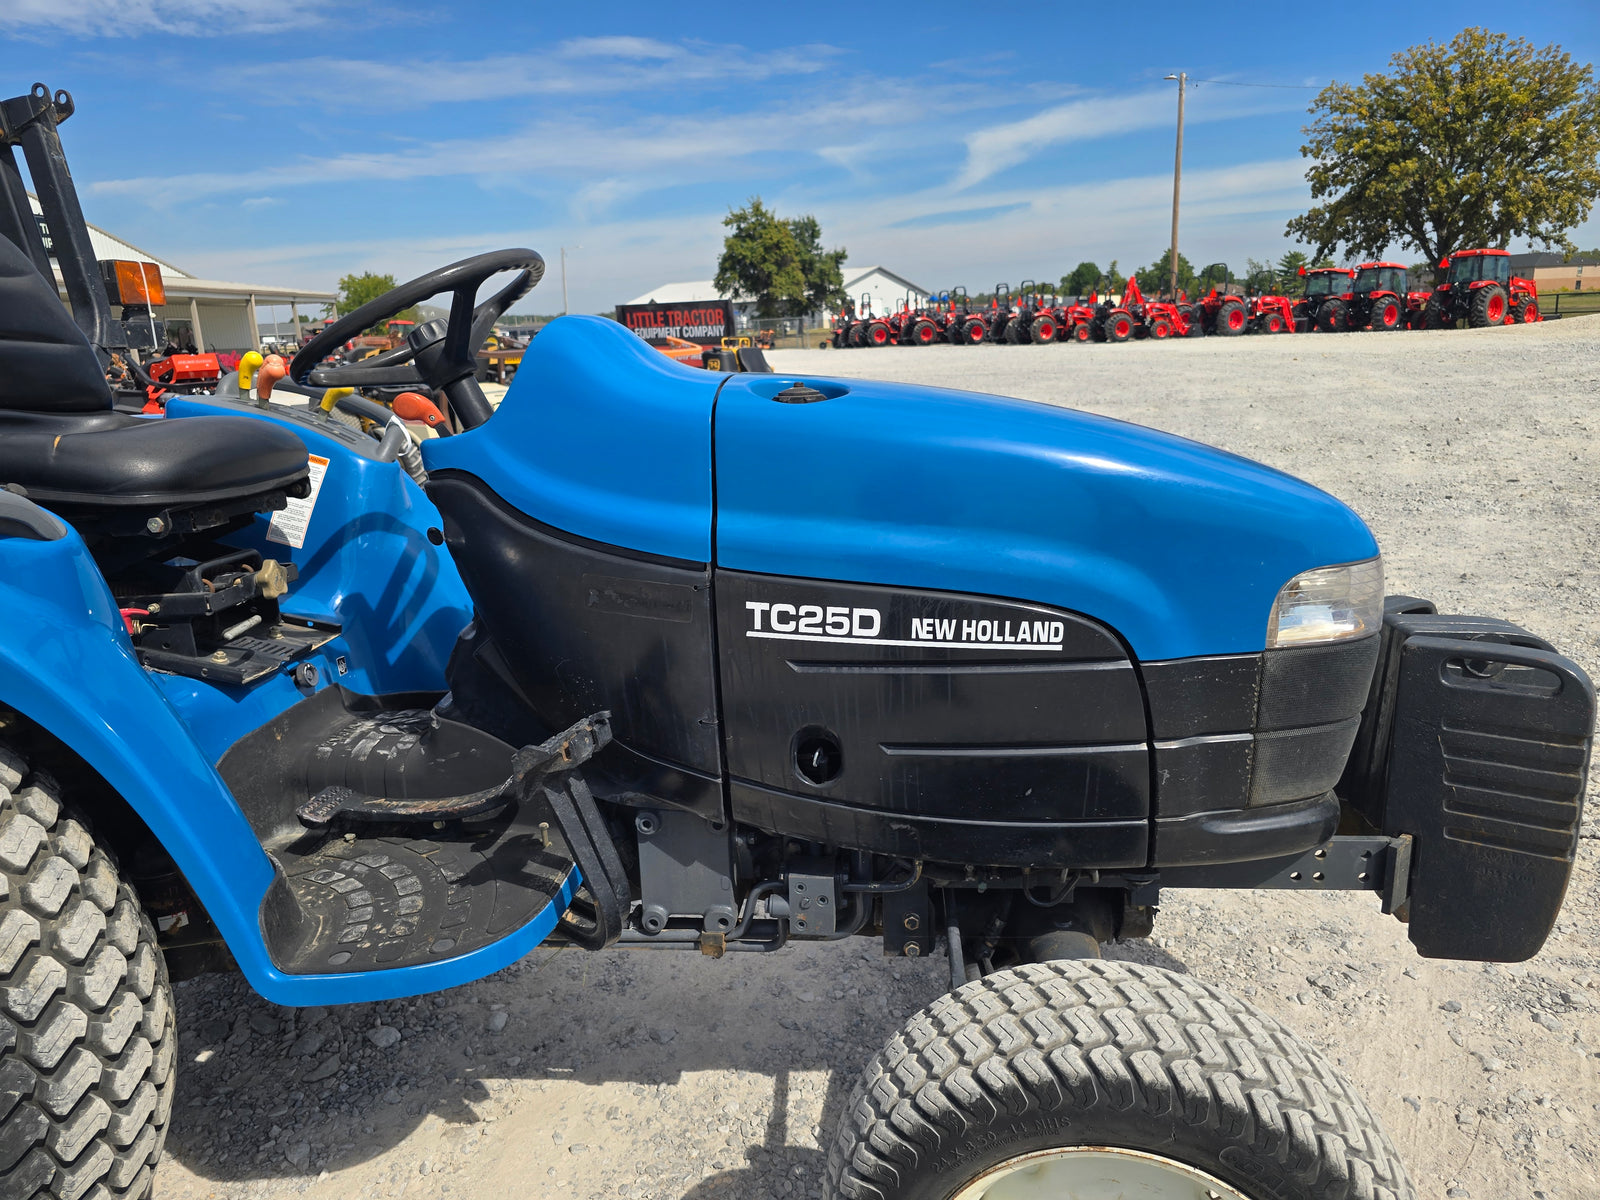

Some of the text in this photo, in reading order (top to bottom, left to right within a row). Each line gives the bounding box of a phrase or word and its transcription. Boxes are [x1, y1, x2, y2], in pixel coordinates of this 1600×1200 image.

[626, 309, 725, 328] LITTLE TRACTOR
[635, 326, 725, 339] EQUIPMENT COMPANY
[745, 601, 881, 637] TC25D
[911, 617, 1064, 643] NEW HOLLAND
